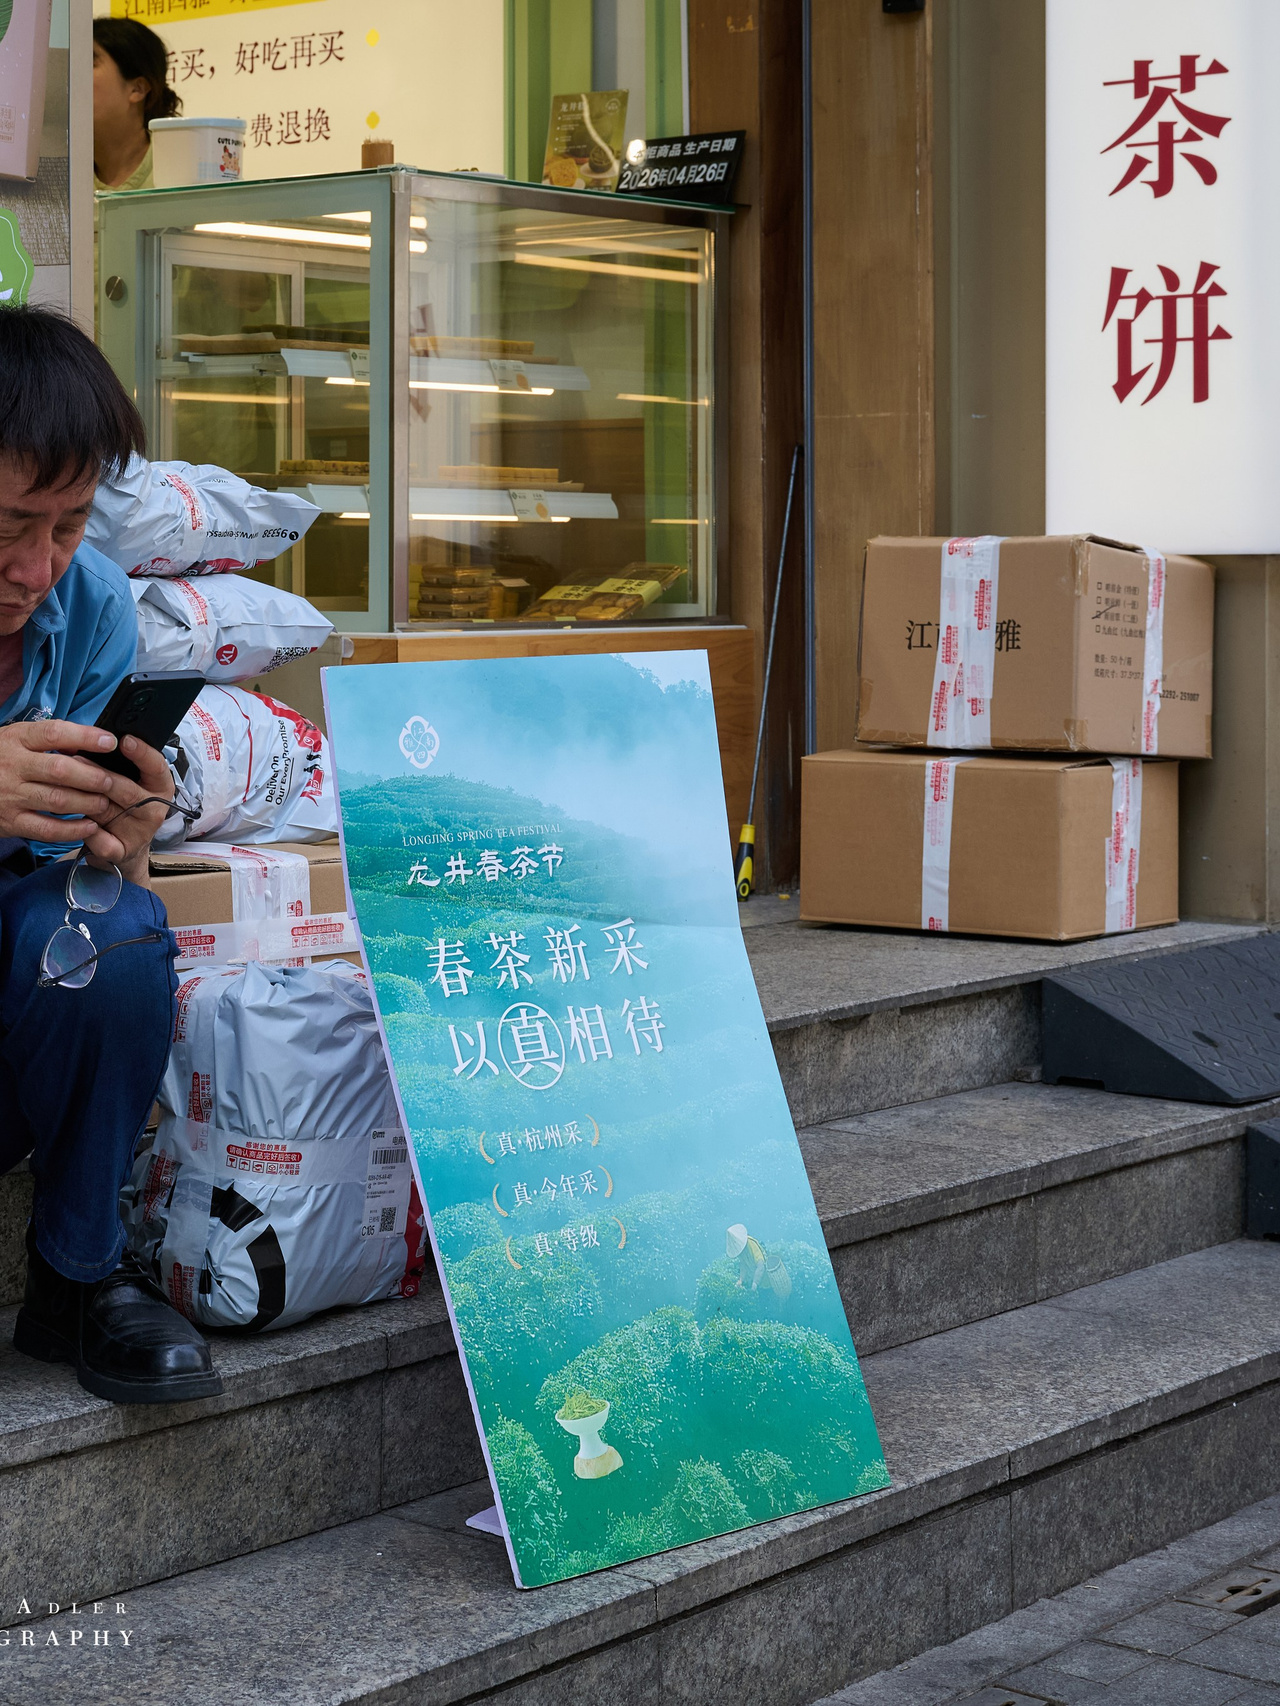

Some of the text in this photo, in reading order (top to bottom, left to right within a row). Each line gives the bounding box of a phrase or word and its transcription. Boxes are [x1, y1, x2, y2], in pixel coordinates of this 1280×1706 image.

[238, 106, 332, 150] 费退换
[683, 137, 737, 156] 生产日期
[619, 162, 729, 190] 2026年04月26日
[1099, 54, 1233, 407] 茶饼
[261, 527, 288, 540] 95338
[905, 619, 1022, 654] 江雅
[219, 645, 236, 665] XL
[275, 787, 286, 806] Our
[402, 822, 563, 848] LONGJING SPRING TEA FESTIVAL
[406, 841, 565, 888] 龙井春茶节
[425, 916, 650, 999] 春茶新采
[448, 996, 667, 1084] 以真相待
[496, 1119, 584, 1158] 真·杭州采
[511, 1169, 600, 1208] 真·今年采
[533, 1223, 601, 1259] 真·等级
